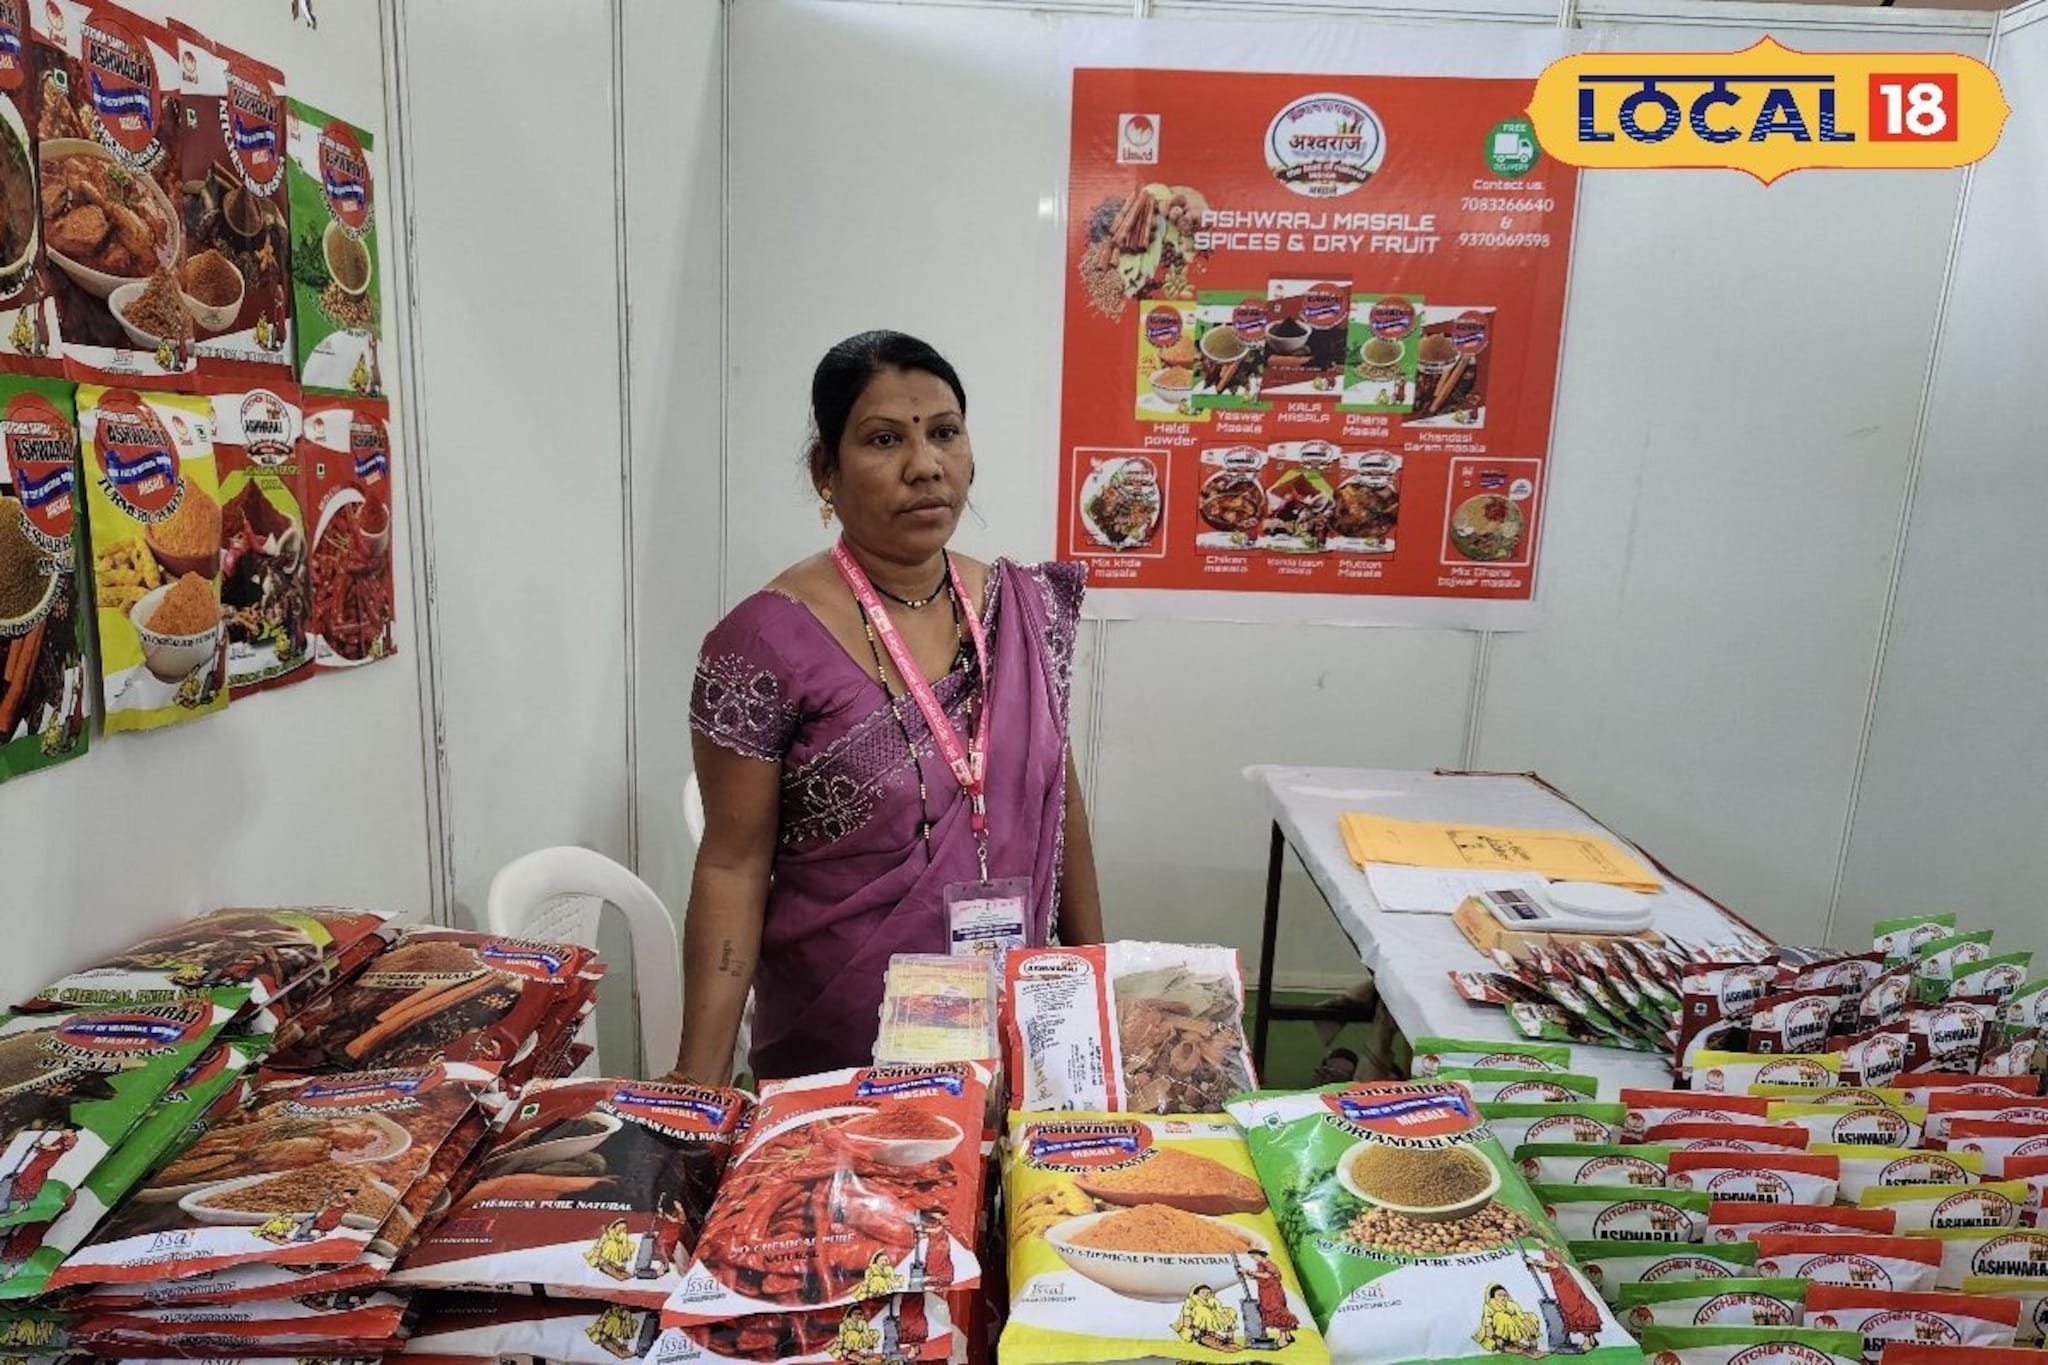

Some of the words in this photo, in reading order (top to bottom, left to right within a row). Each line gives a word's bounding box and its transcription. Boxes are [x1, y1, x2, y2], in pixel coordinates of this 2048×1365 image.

[1503, 124, 1527, 132] FREE
[1472, 179, 1524, 190] Contact
[1461, 197, 1554, 212] 7083266640
[1201, 211, 1327, 229] ASHWRAJ
[1333, 213, 1436, 231] MASALE
[1500, 216, 1512, 229] &
[1193, 231, 1280, 250] SPICES
[1287, 234, 1304, 251] &
[1313, 234, 1363, 252] DRY
[1370, 237, 1440, 253] FRUIT
[1459, 232, 1551, 247] 9370069598
[1288, 403, 1322, 412] KALA
[1144, 434, 1197, 446] powder
[1395, 1109, 1449, 1125] MASALE
[1324, 1115, 1443, 1149] CORIANDER
[1529, 1117, 1570, 1139] KITCHEN
[1581, 1157, 1624, 1180] KITCHEN
[1711, 1168, 1752, 1190] KITCHEN
[540, 1200, 574, 1209] PURE
[576, 1201, 633, 1210] NATURAL
[1600, 1203, 1648, 1226] KITCHEN
[822, 1232, 855, 1244] PURE
[1980, 1234, 2031, 1257] KITCHEN
[1058, 1247, 1074, 1255] NO
[1078, 1250, 1139, 1264] CHEMICAL
[1143, 1256, 1174, 1265] PURE
[1179, 1256, 1229, 1265] NATURAL
[1414, 1255, 1451, 1266] PURE
[1456, 1248, 1515, 1266] NATURAL
[1643, 1260, 1692, 1282] KITCHEN
[1802, 1256, 1846, 1276] KITCHEN
[1978, 1259, 2048, 1277] ASHWARA
[1698, 1294, 1747, 1325] KITCHEN
[1863, 1311, 1912, 1333] KITCHEN
